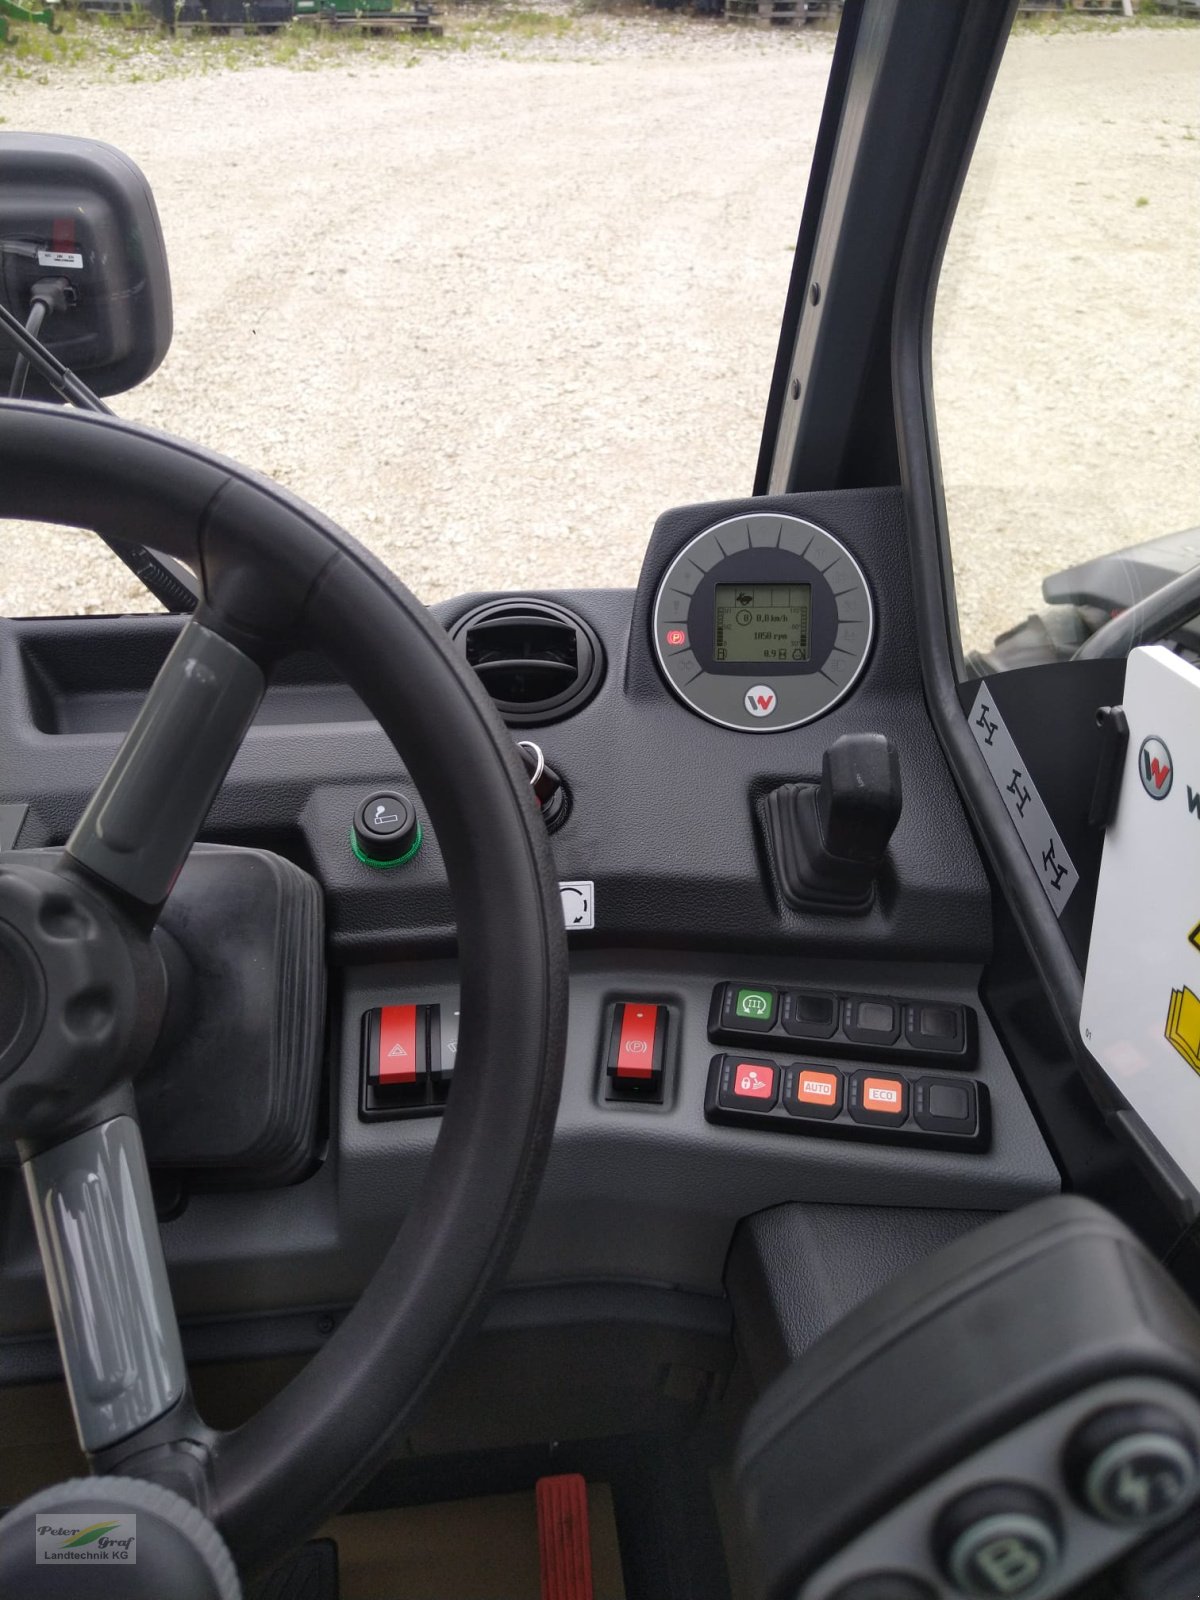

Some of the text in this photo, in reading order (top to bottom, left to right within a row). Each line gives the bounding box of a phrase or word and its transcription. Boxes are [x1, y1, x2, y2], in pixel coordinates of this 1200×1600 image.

[771, 613, 788, 622] km/h
[773, 633, 788, 641] rpm
[805, 1082, 830, 1094] AUTO
[872, 1090, 893, 1100] ECO
